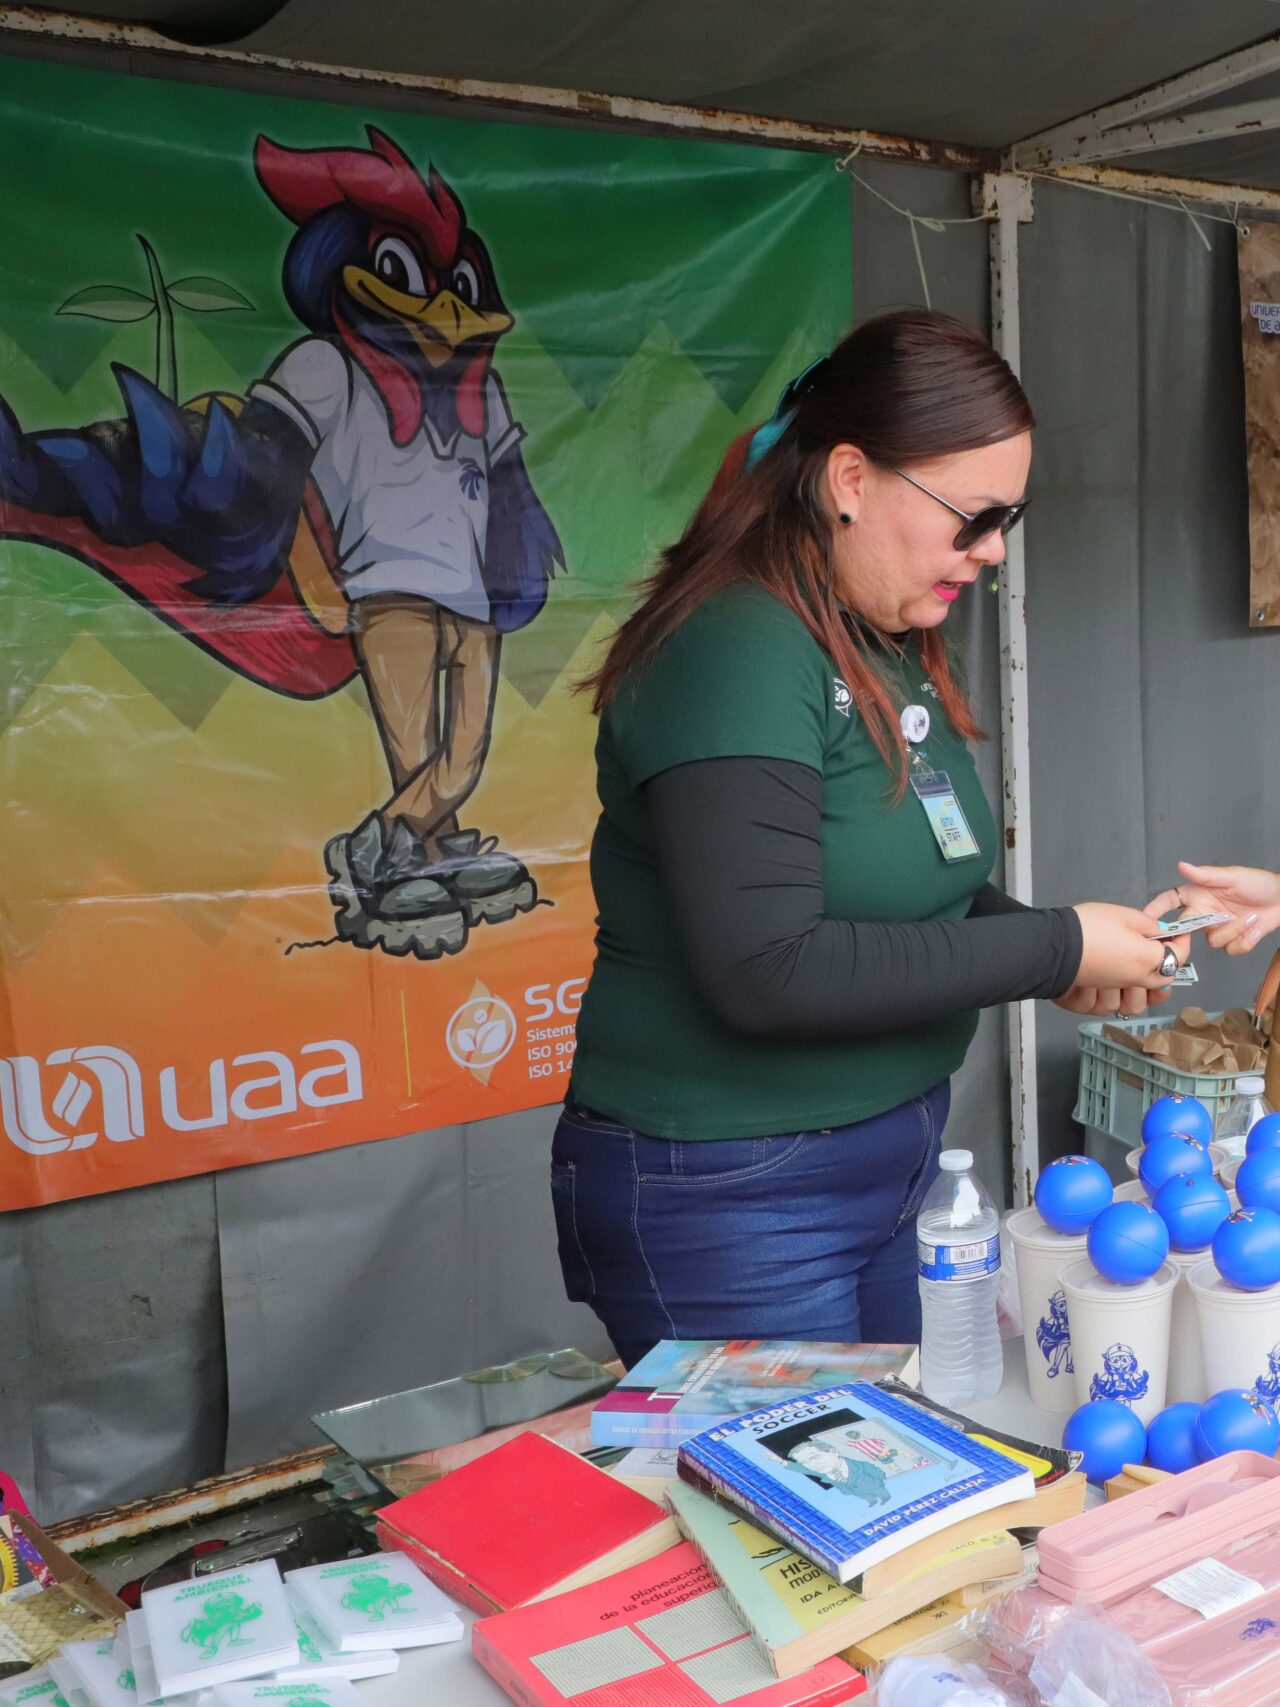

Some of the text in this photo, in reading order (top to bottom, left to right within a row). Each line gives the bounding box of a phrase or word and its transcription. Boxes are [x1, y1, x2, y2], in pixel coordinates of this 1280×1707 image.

[527, 1045, 552, 1061] ISO
[528, 1063, 553, 1079] ISO
[708, 1388, 852, 1442] EL PODER DEL
[752, 1404, 831, 1435] SOCCER
[863, 1476, 987, 1536] DAVID PÉREZ CALLEJA
[319, 1563, 391, 1580] AMBIENTAL
[321, 1560, 380, 1575] TRUEQUE
[174, 1577, 254, 1602] AMBIENTAL
[179, 1573, 246, 1594] TRUEQUE
[630, 1562, 706, 1602] planeación
[800, 1590, 823, 1604] IDA
[600, 1611, 620, 1621] de
[622, 1604, 638, 1613] la
[253, 1687, 332, 1698] AMBIENTAL
[256, 1682, 320, 1694] TRUEQUE
